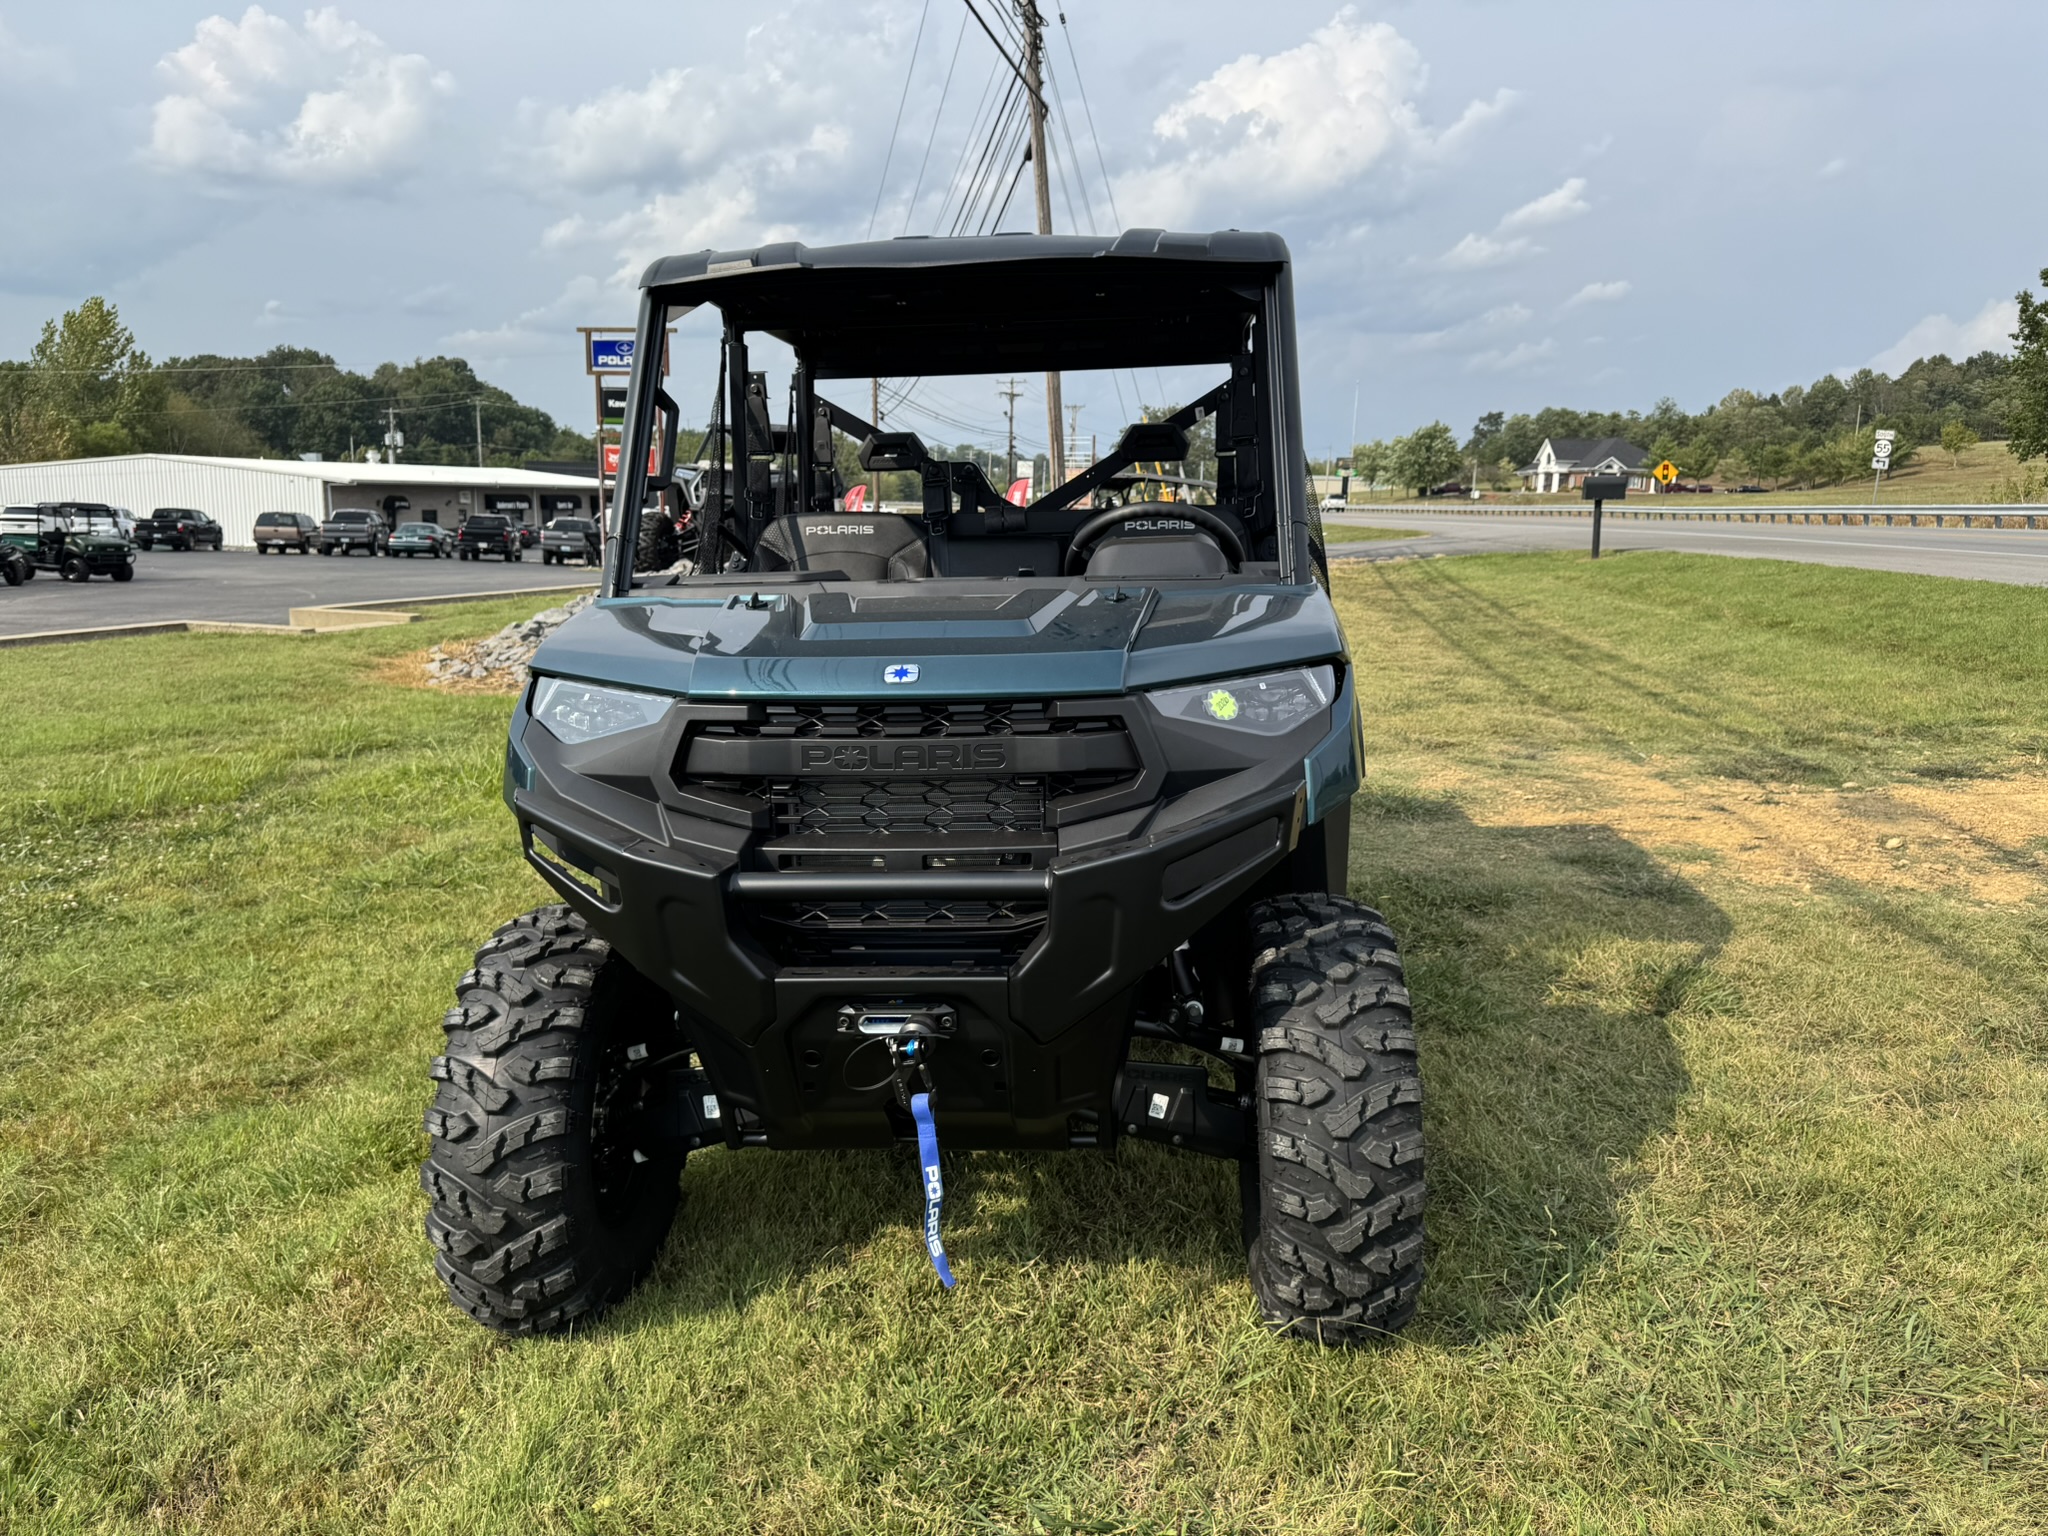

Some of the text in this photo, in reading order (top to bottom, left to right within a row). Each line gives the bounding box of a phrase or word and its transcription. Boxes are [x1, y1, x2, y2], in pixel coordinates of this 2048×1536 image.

[598, 355, 633, 366] POLA
[1876, 443, 1890, 454] 55
[806, 525, 874, 536] POLARIS
[1125, 520, 1195, 531] POLARIS
[801, 744, 1006, 771] POLARIS
[925, 1165, 943, 1257] POLARIS
